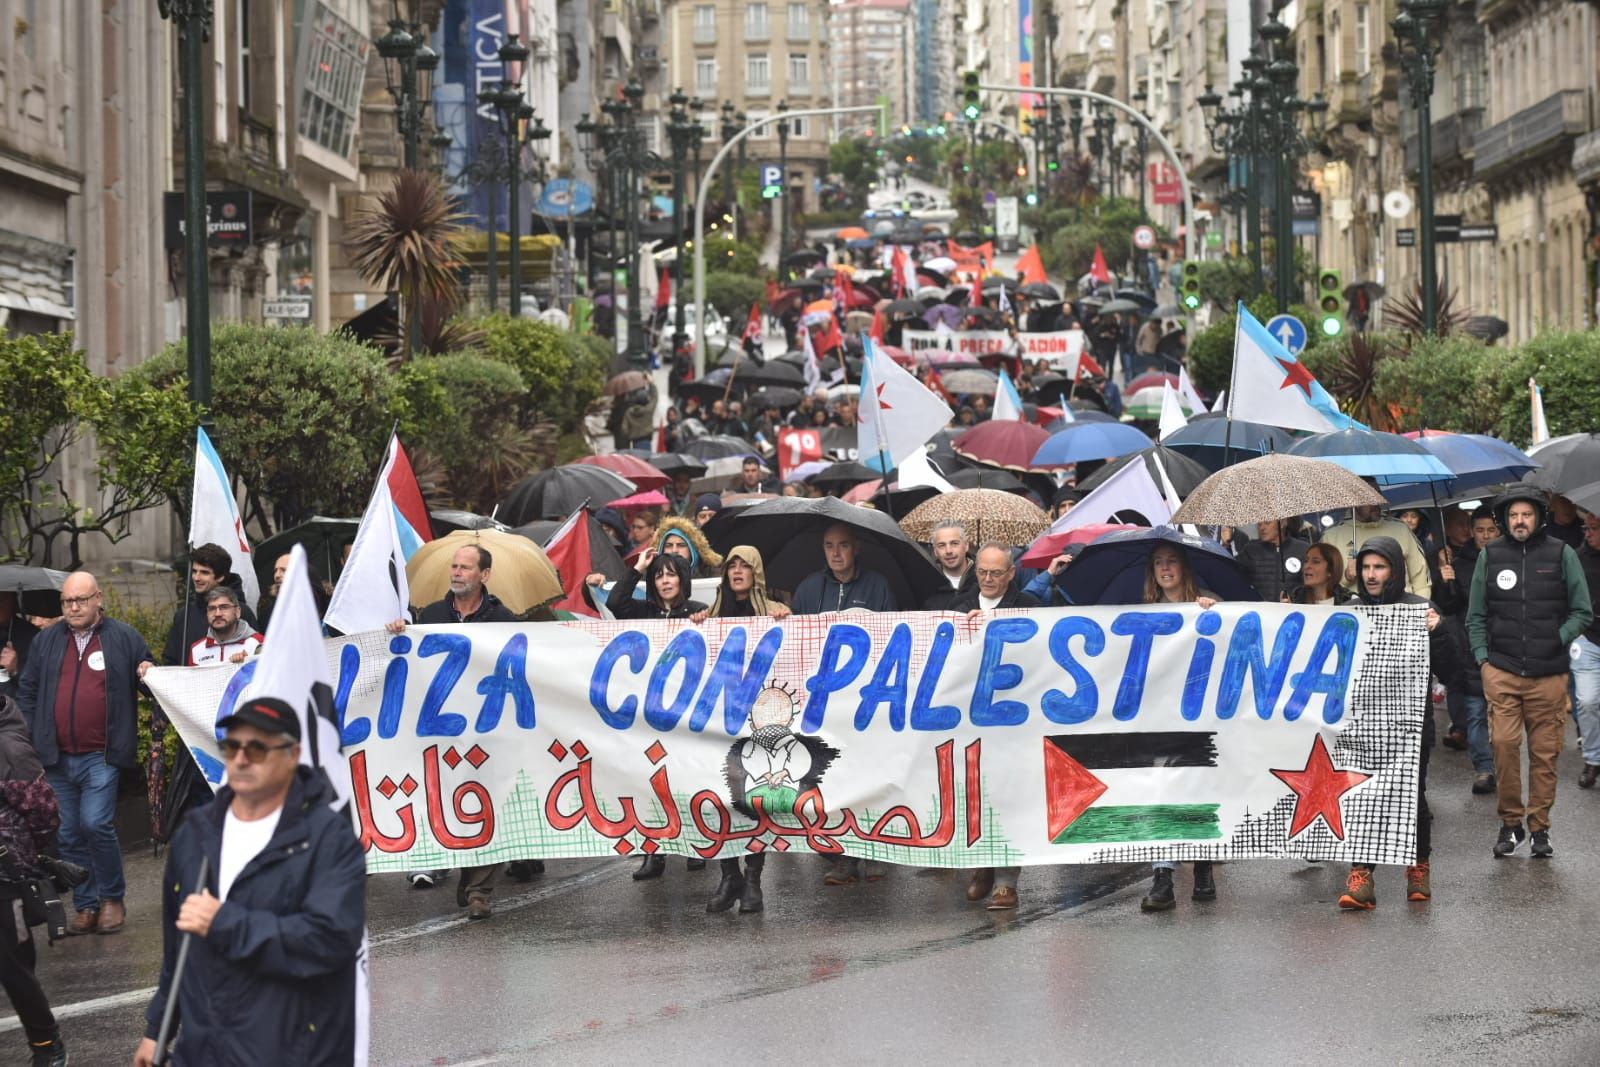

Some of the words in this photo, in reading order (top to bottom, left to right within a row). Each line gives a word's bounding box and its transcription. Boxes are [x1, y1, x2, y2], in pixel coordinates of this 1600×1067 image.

[764, 167, 782, 186] P
[589, 626, 784, 736] CON
[349, 743, 496, 855] قاتل
